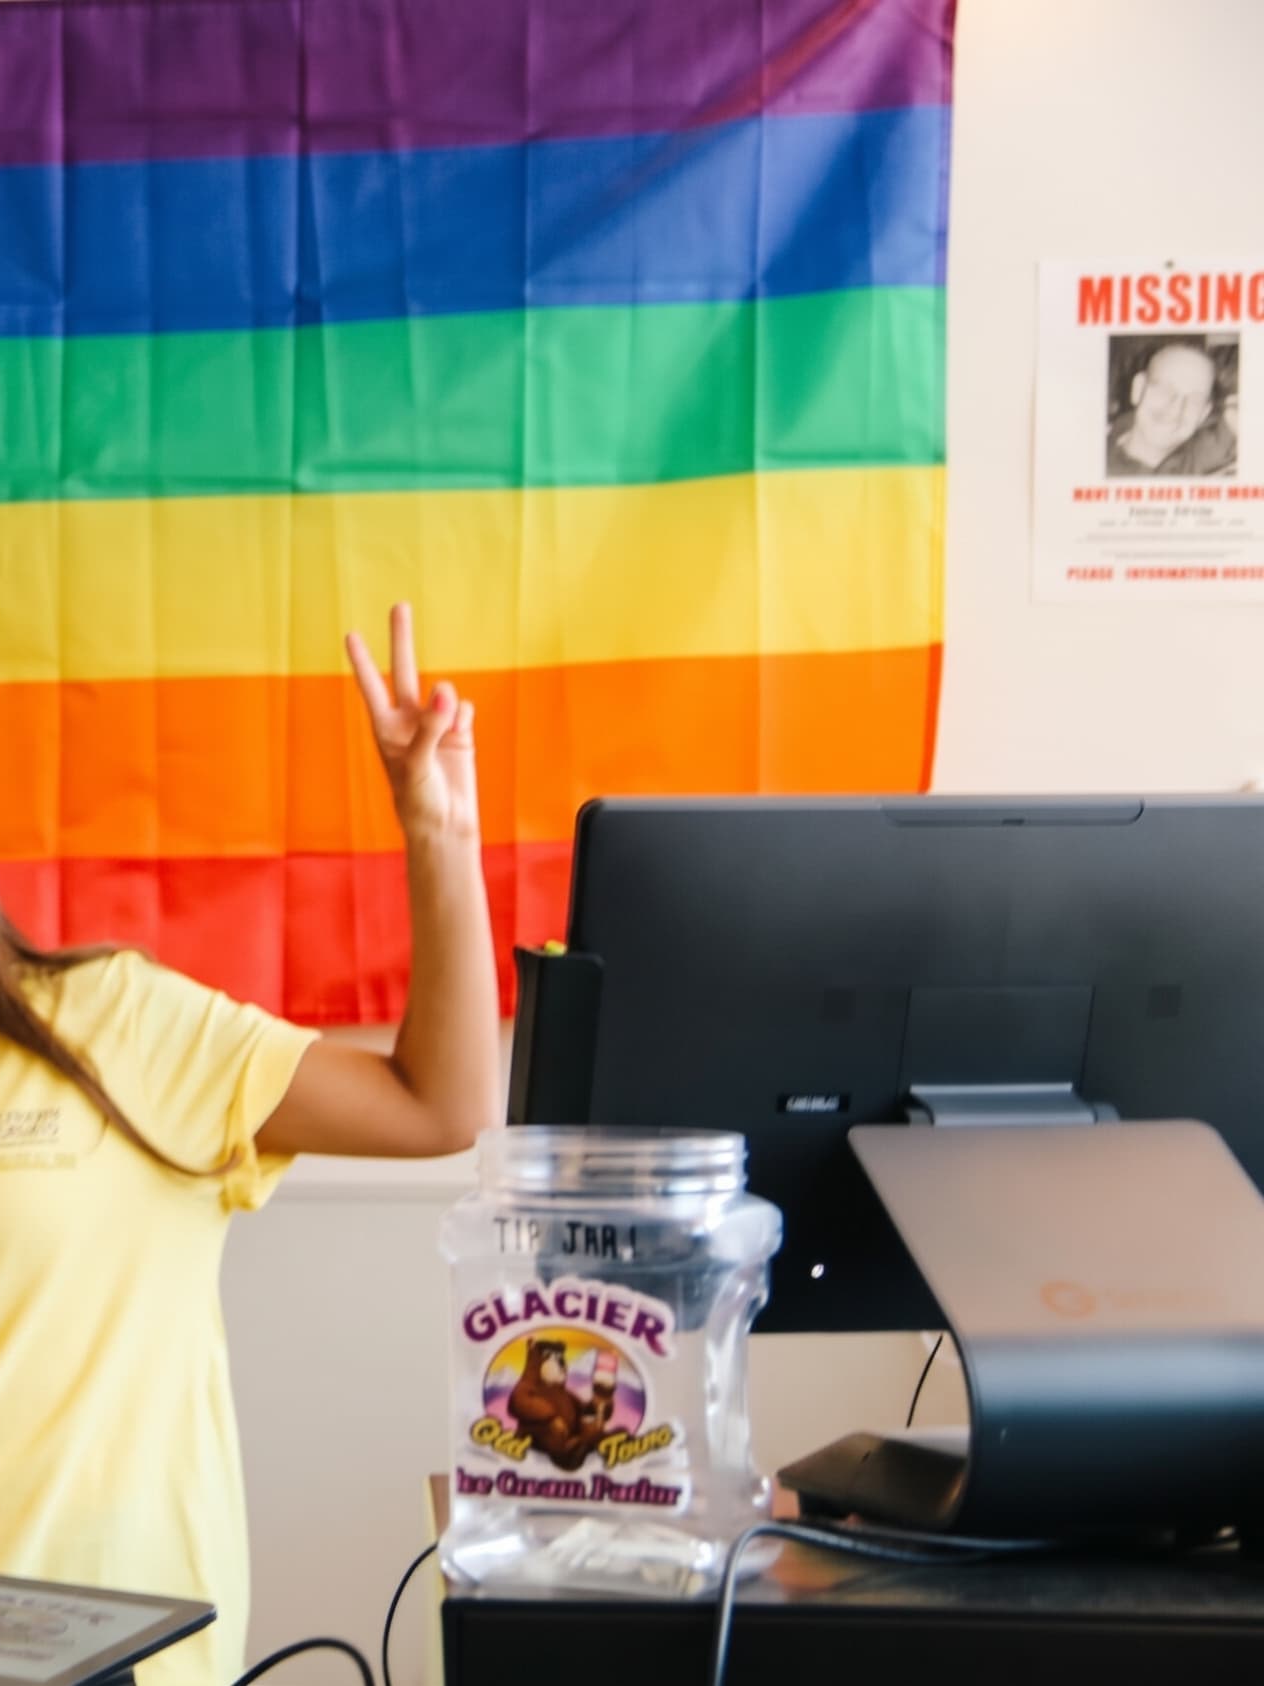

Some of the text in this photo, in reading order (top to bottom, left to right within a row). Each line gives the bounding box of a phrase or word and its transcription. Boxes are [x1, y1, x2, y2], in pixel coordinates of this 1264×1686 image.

[1078, 271, 1264, 325] MISSING
[493, 1217, 541, 1253] TIP
[462, 1286, 667, 1358] GLACIER
[470, 1417, 675, 1468] Old Town
[496, 1468, 585, 1500] Cream
